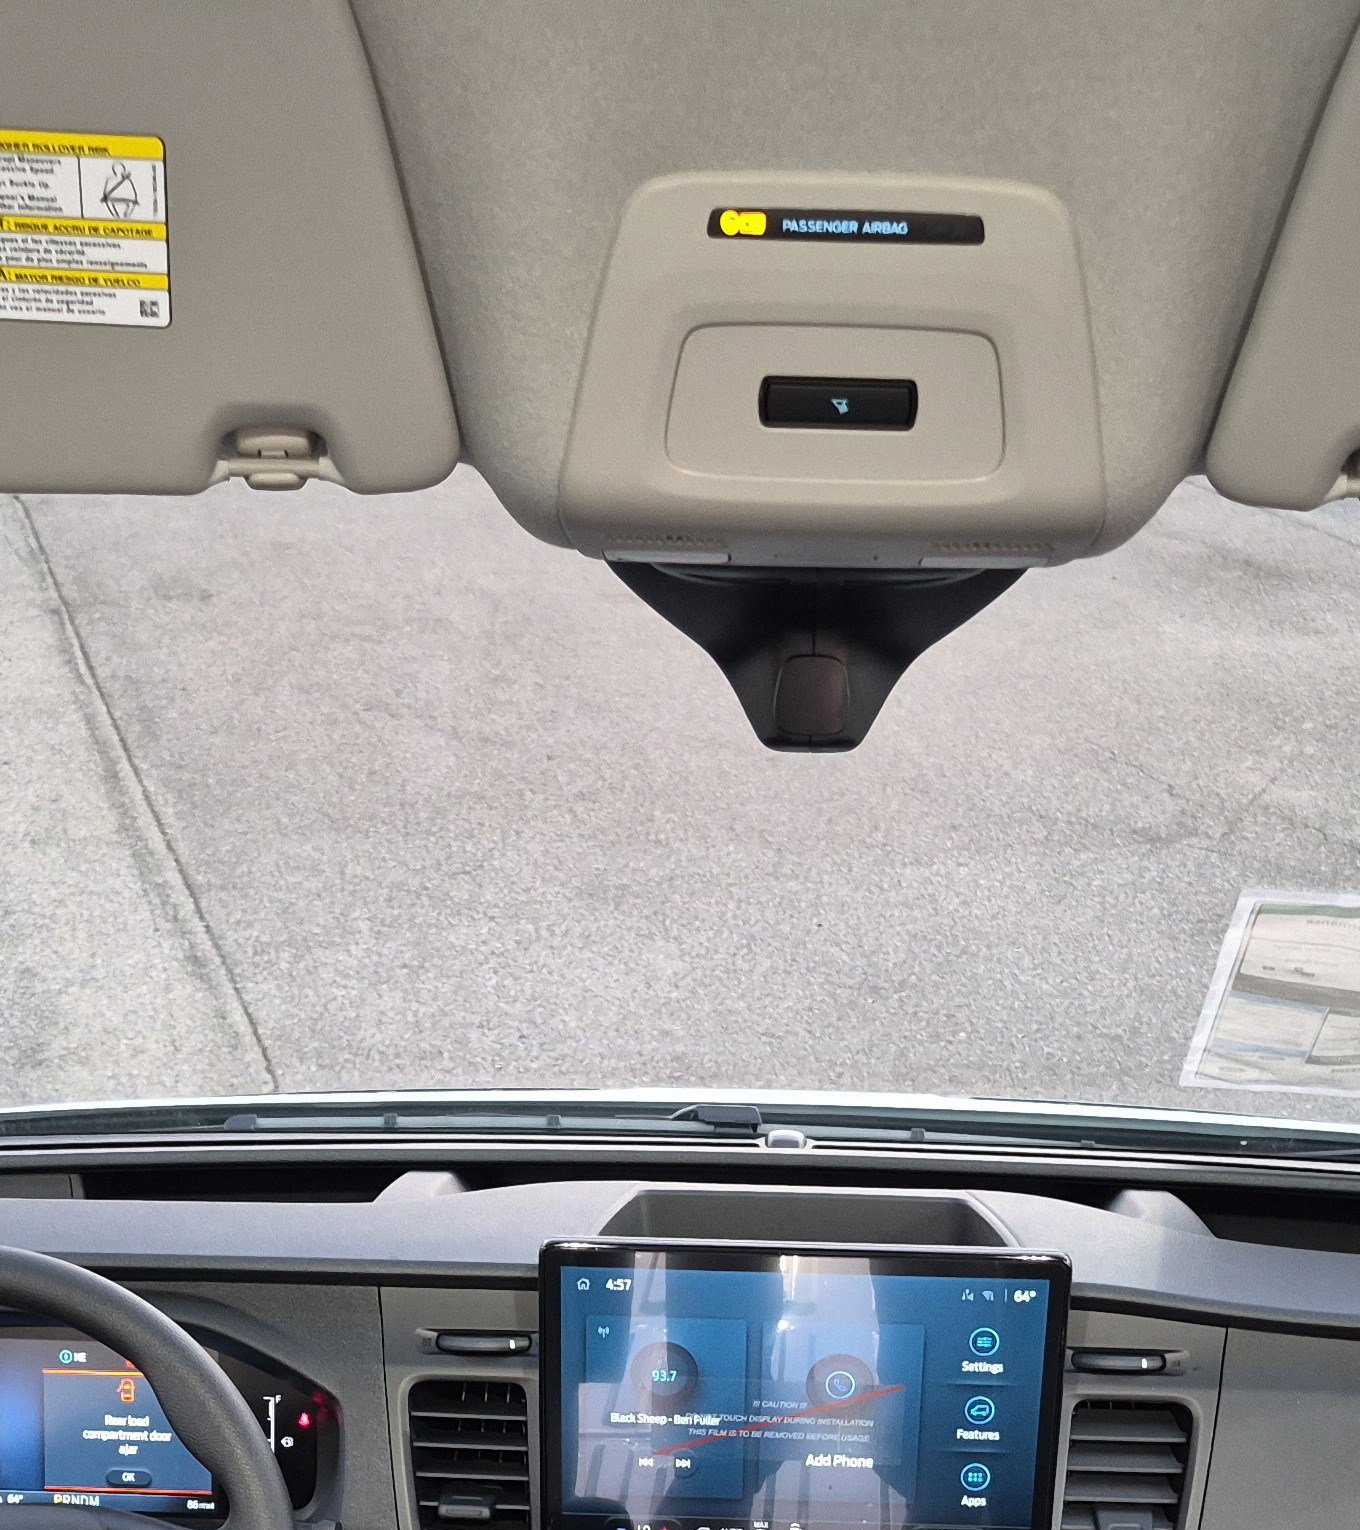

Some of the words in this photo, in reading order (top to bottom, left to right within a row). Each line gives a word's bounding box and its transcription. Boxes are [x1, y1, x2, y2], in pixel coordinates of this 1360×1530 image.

[782, 219, 858, 235] PASSENGER
[606, 1278, 631, 1291] 4:57
[73, 1352, 87, 1362] NE
[962, 1361, 1004, 1374] Settings
[652, 1370, 678, 1383] 93.7
[104, 1415, 127, 1427] Rear
[127, 1415, 150, 1427] load
[610, 1412, 636, 1423] Black
[637, 1412, 667, 1425] Sheep
[673, 1414, 693, 1425] Ben
[82, 1430, 148, 1442] compartment
[149, 1431, 172, 1442] door
[956, 1429, 1000, 1441] Features
[118, 1444, 138, 1456] ajar
[805, 1454, 832, 1467] Add
[833, 1455, 874, 1468] Phone
[121, 1472, 136, 1482] OK
[961, 1495, 987, 1508] Apps
